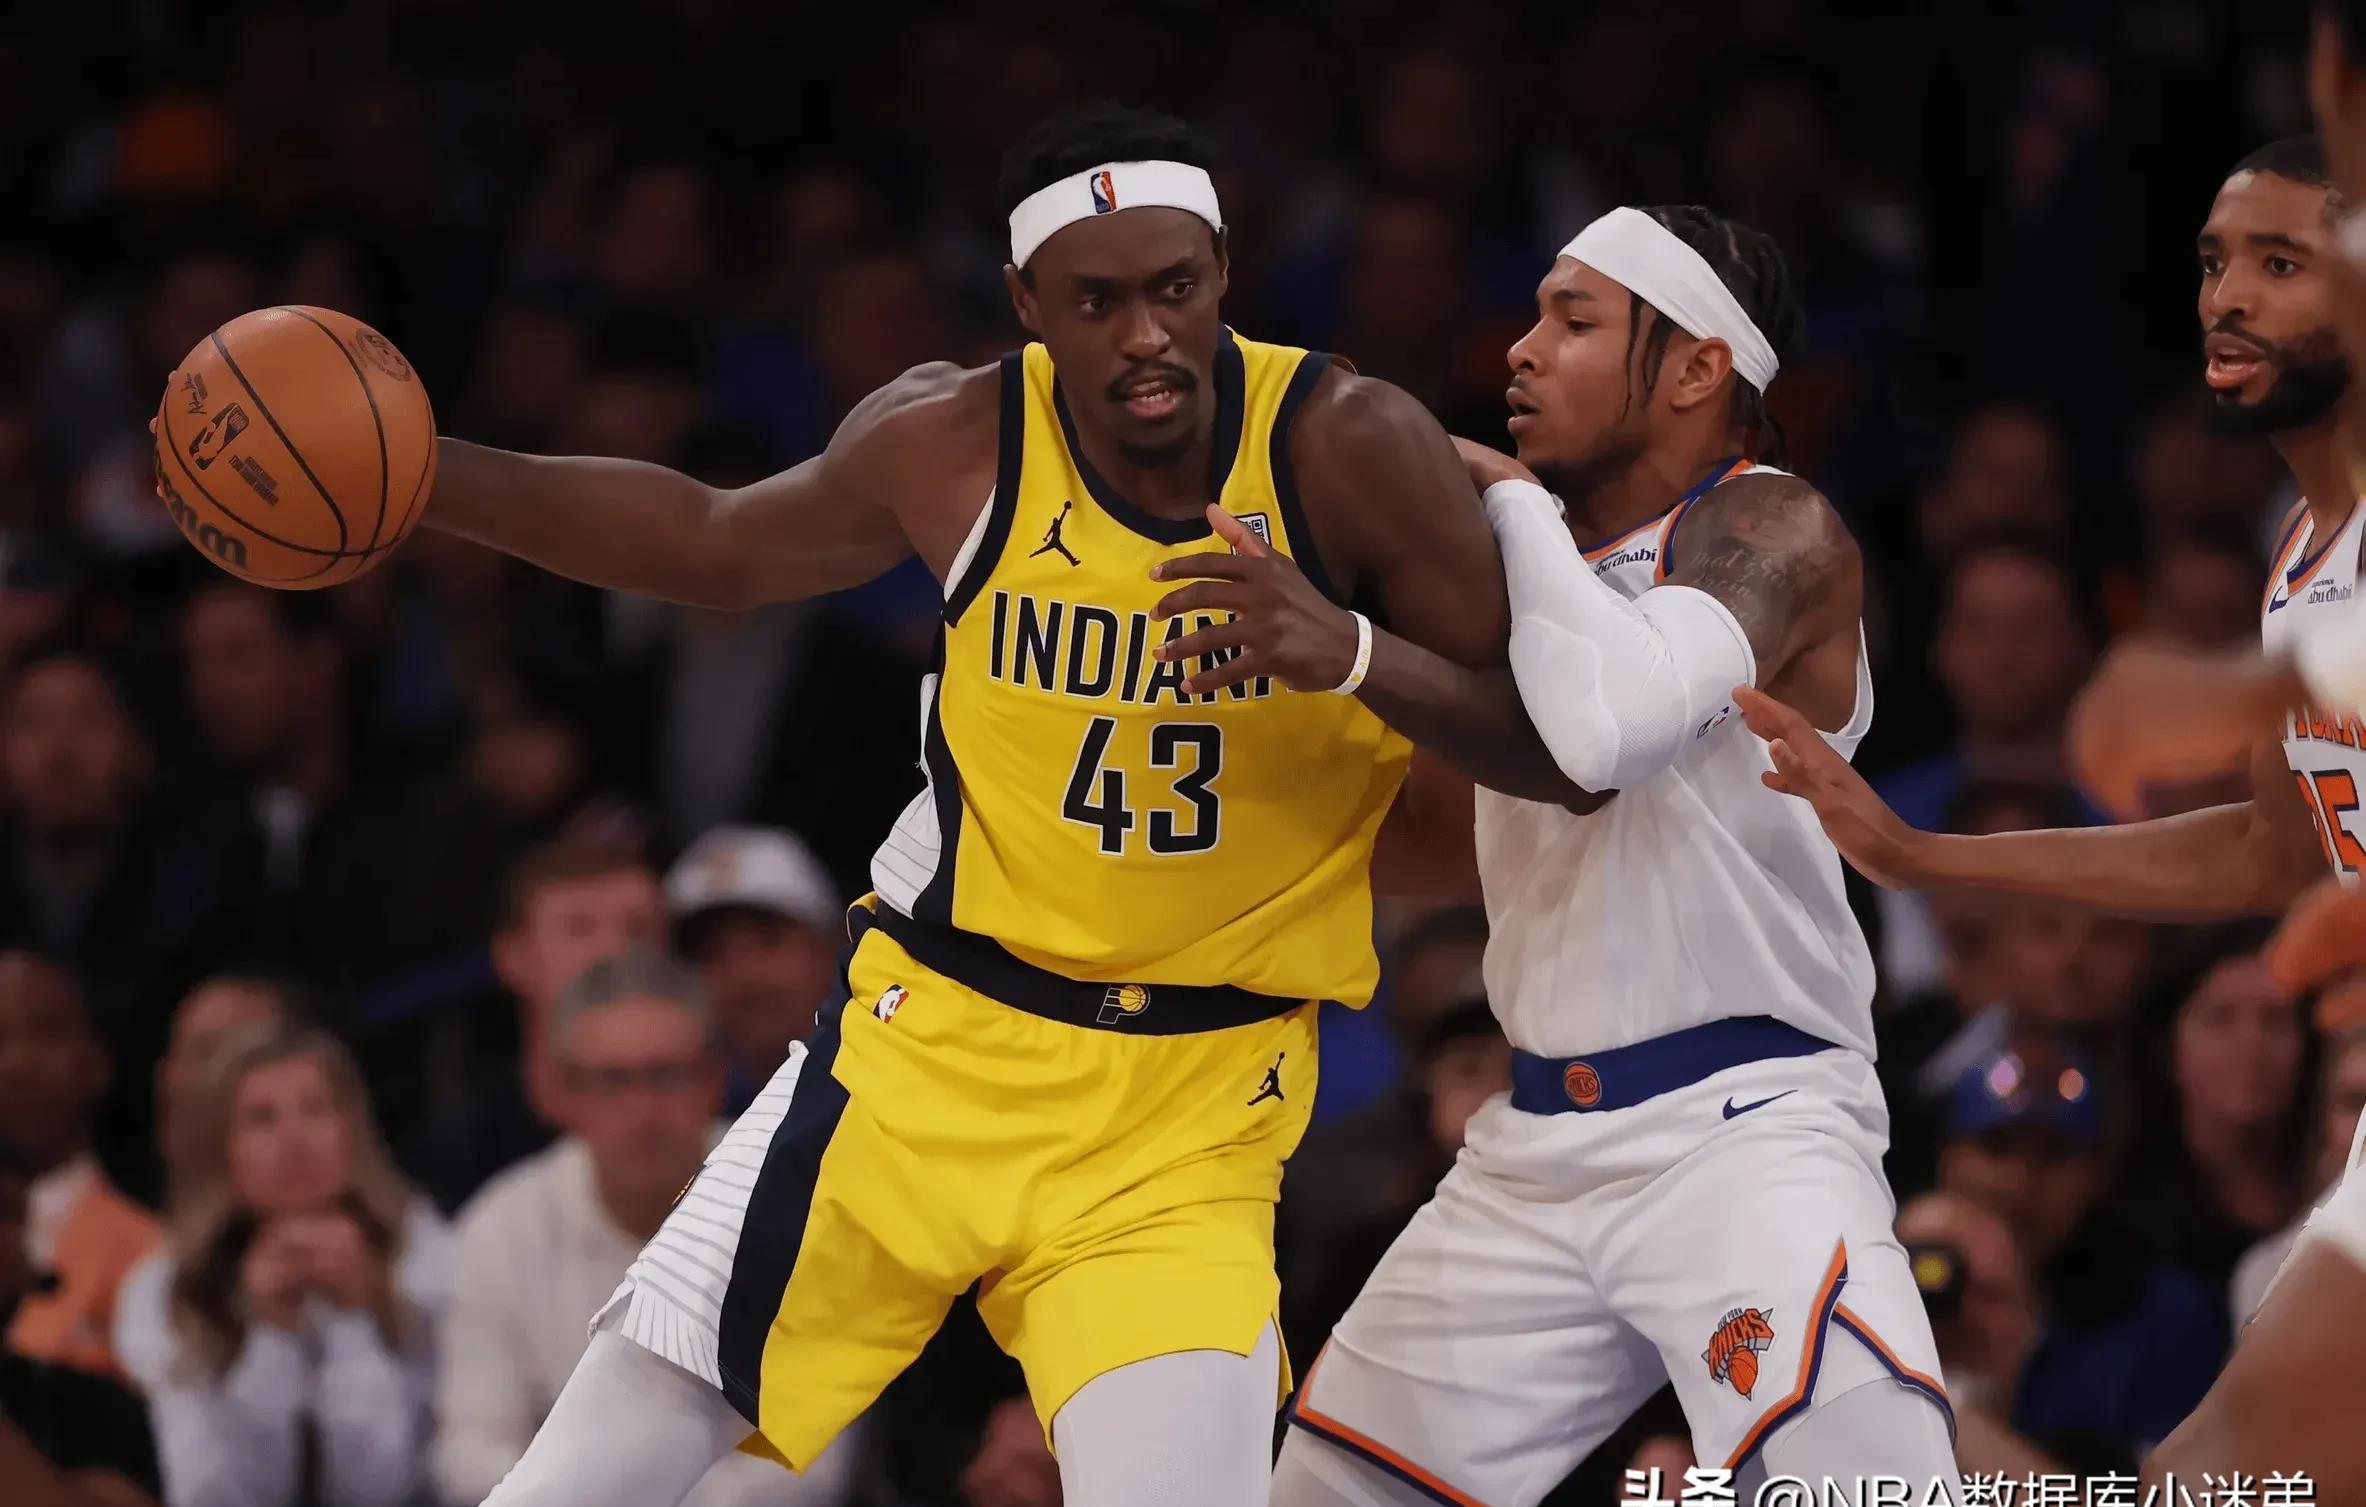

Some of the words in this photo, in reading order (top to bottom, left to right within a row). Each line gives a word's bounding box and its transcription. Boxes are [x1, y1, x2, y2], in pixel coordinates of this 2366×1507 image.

[1612, 547, 1658, 567] dhabi
[988, 588, 1296, 707] INDIAN
[1060, 714, 1224, 857] 43
[1708, 1308, 1774, 1380] KNICKS
